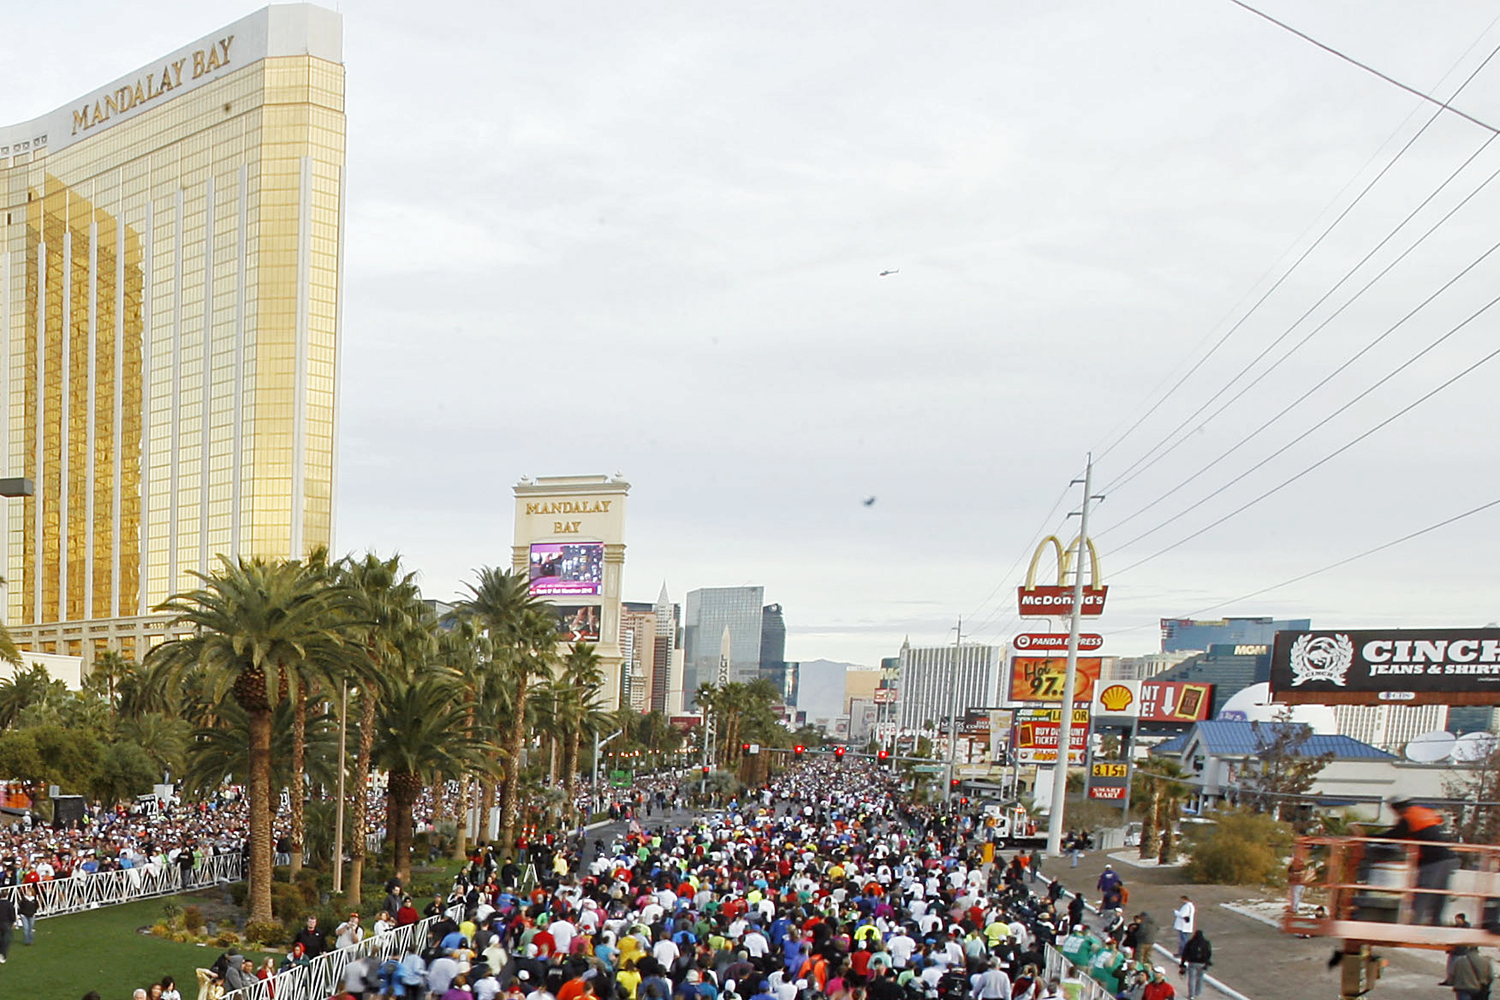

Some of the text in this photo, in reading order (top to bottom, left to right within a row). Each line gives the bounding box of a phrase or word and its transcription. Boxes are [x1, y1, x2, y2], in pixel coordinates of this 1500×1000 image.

[71, 34, 235, 136] MANDALAY BAY
[526, 500, 612, 515] MANDALAY
[554, 521, 582, 534] BAY
[1022, 595, 1104, 606] McDonld's
[1031, 637, 1102, 647] PANDA EPRESS
[1233, 644, 1268, 656] MGM
[1369, 664, 1424, 677] JEANS
[1426, 664, 1442, 675] &
[1030, 677, 1064, 696] 97.
[1052, 710, 1088, 722] LIOR
[1035, 727, 1050, 736] BUY
[1095, 791, 1118, 799] MART
